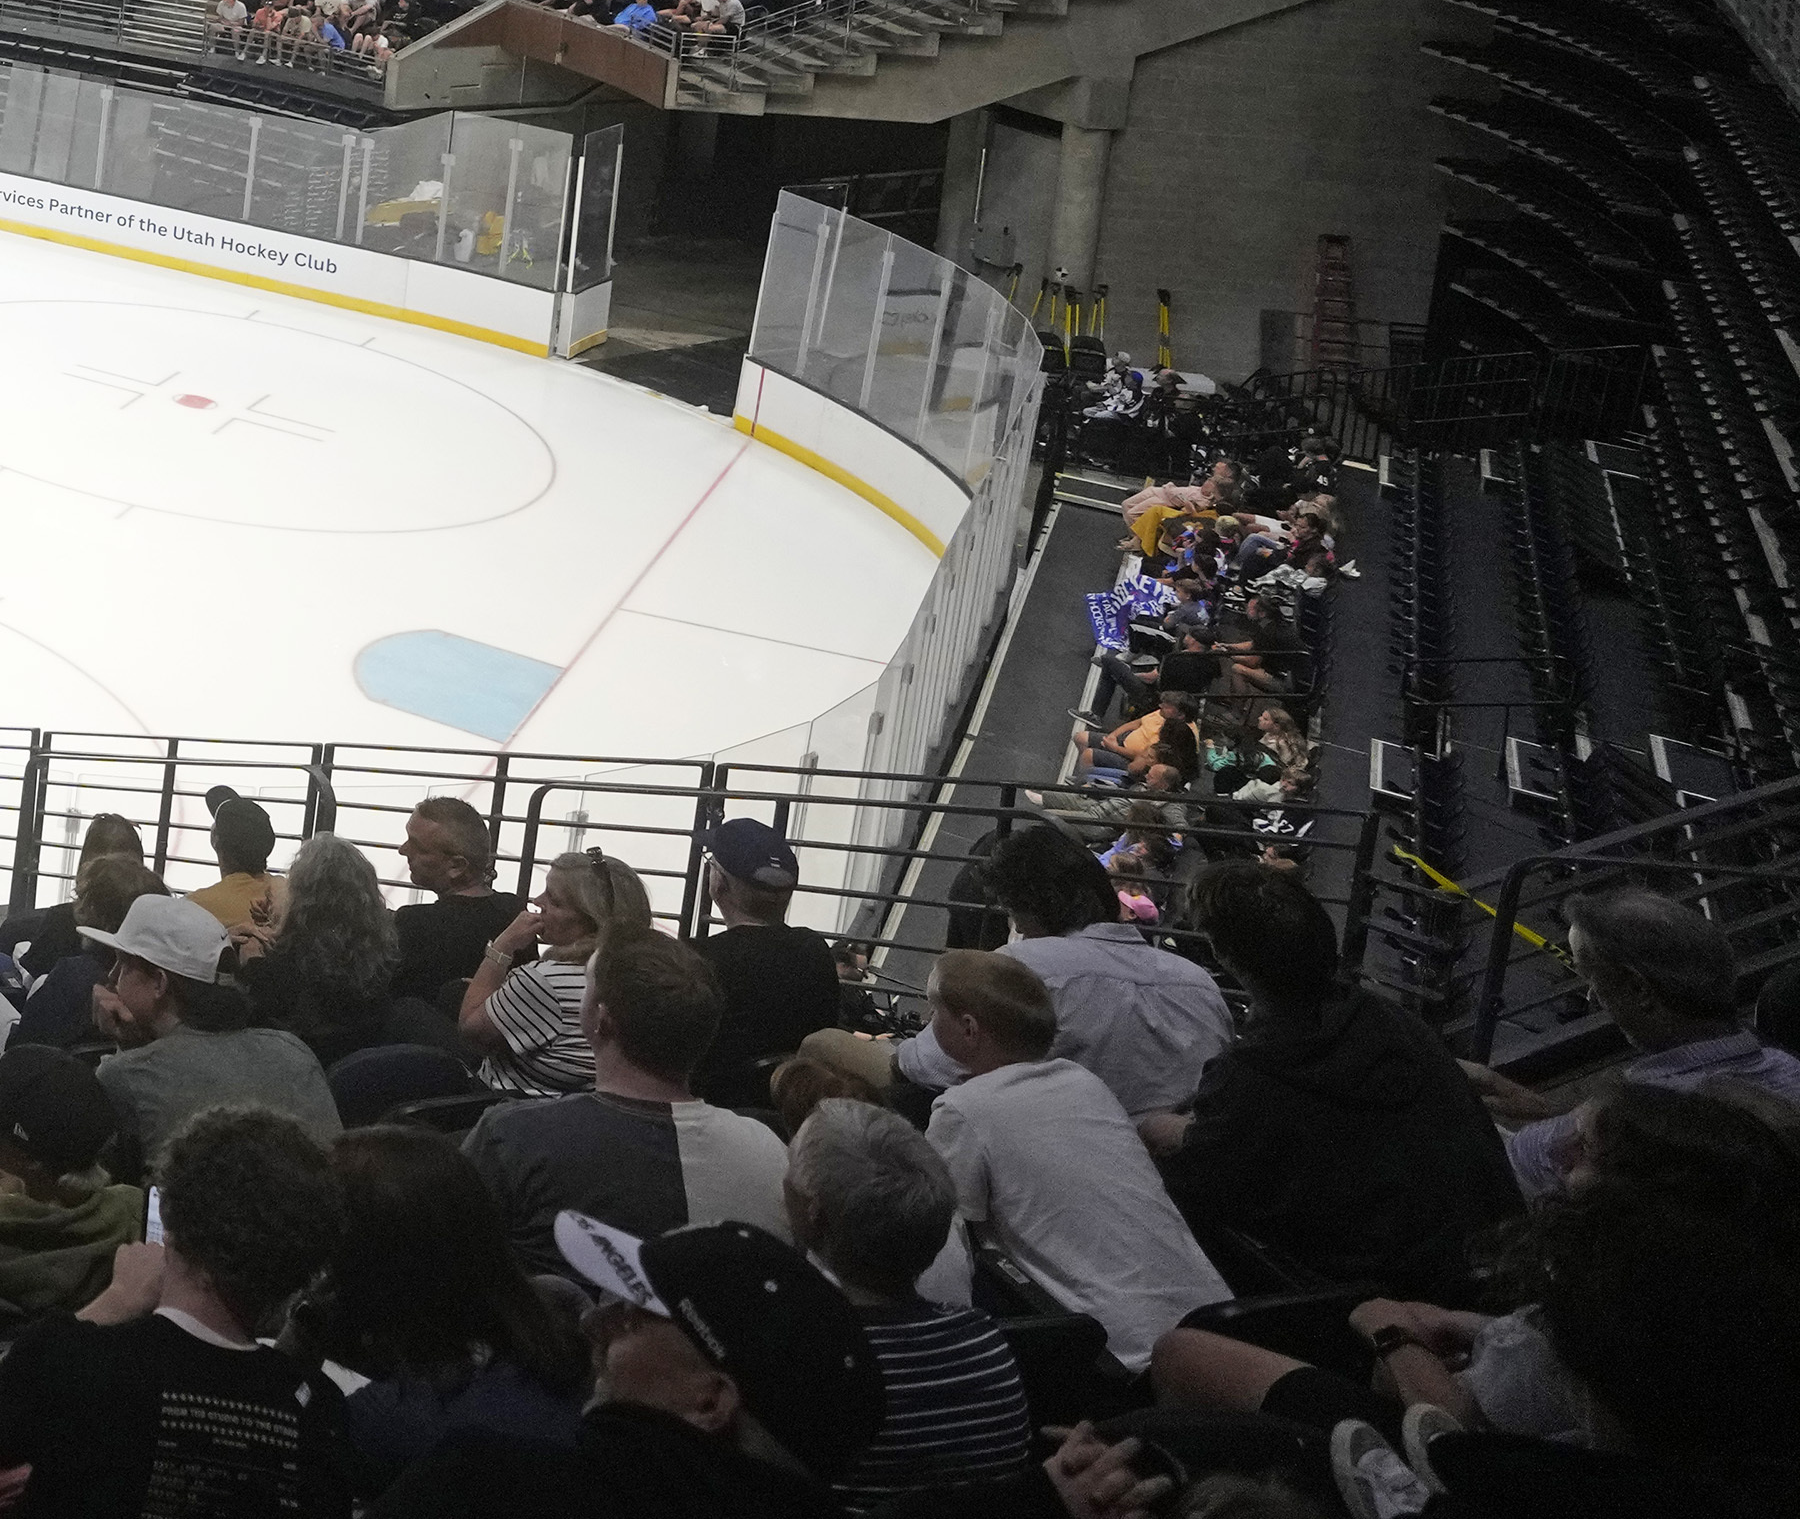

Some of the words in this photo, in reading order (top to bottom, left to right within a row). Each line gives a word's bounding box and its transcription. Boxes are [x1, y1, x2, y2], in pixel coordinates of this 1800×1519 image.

[49, 198, 112, 224] Partner
[116, 210, 136, 229] of
[139, 216, 168, 238] the
[172, 226, 216, 249] Utah
[220, 235, 289, 266] Hockey
[294, 250, 338, 274] Club
